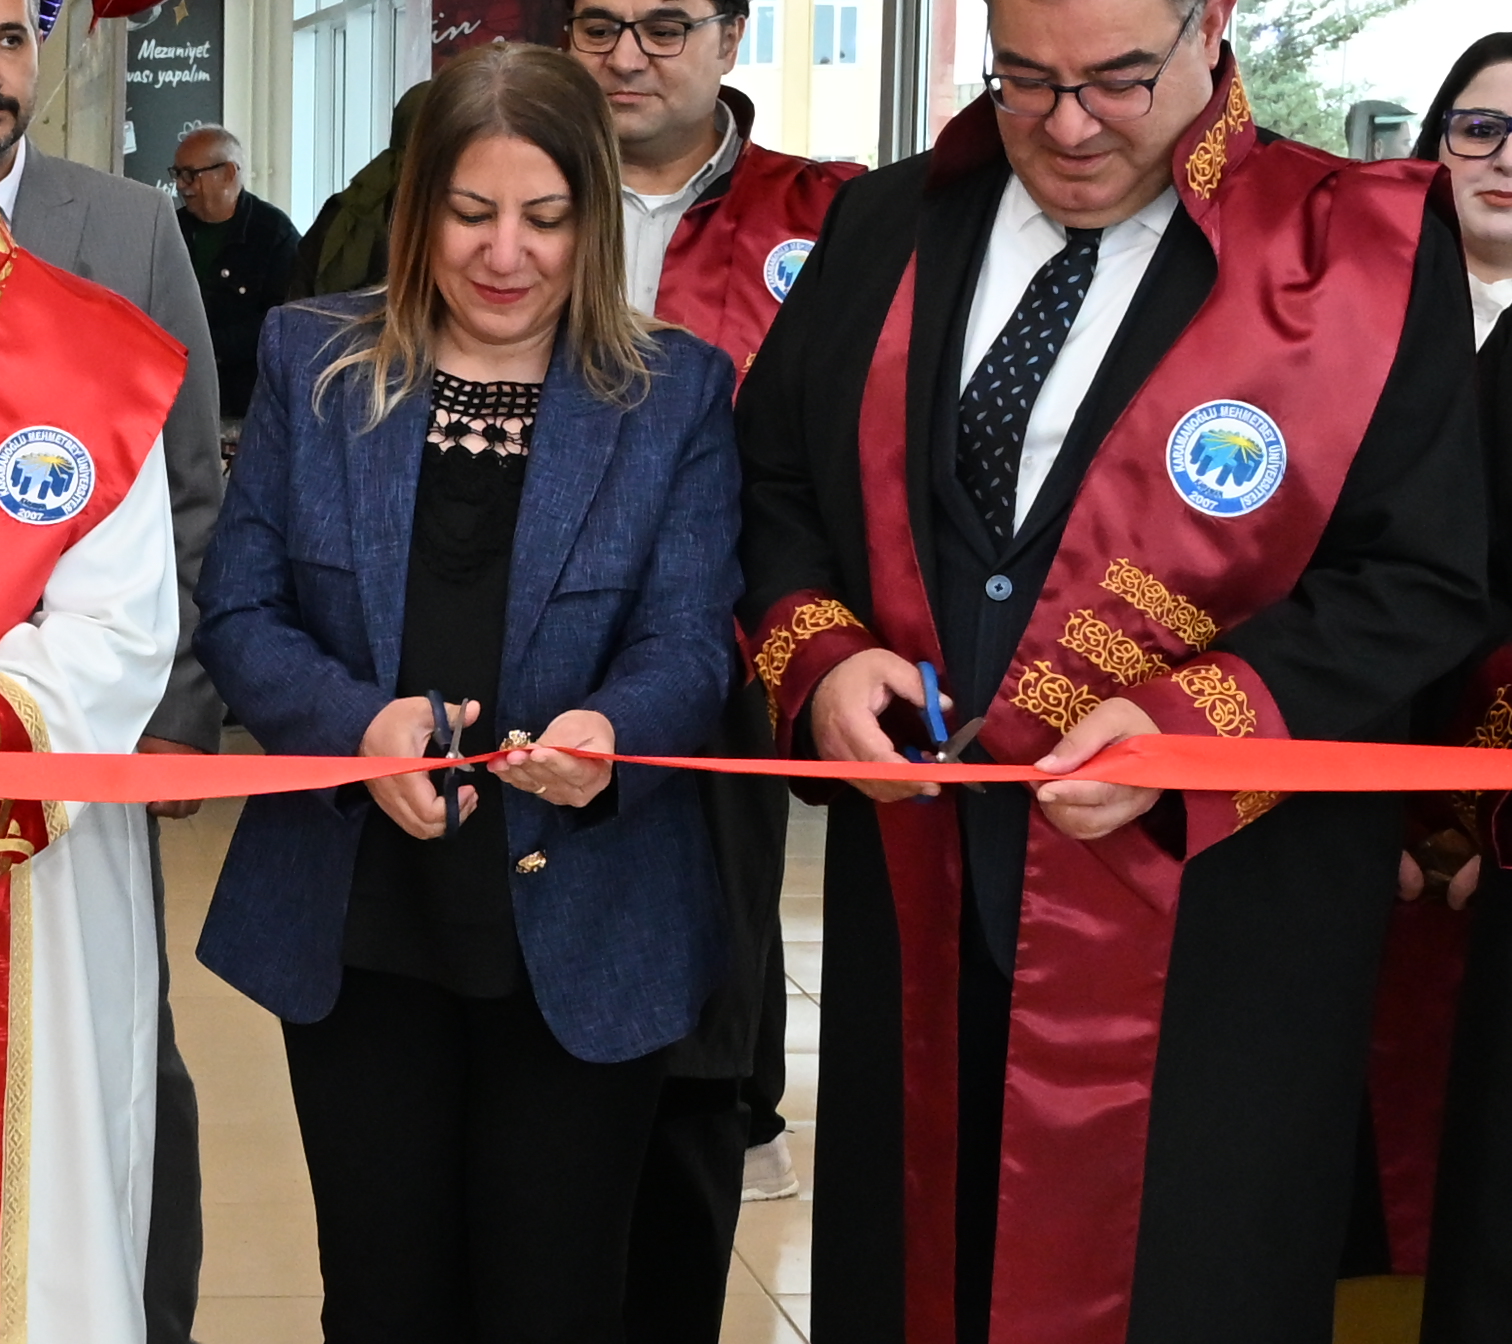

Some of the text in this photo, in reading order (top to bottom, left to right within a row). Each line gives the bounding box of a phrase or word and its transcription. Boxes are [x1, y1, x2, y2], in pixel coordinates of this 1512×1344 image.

[137, 38, 211, 65] Mezuniyet
[154, 63, 211, 89] yapalım
[1188, 490, 1219, 510] 2007
[17, 507, 44, 521] 2007
